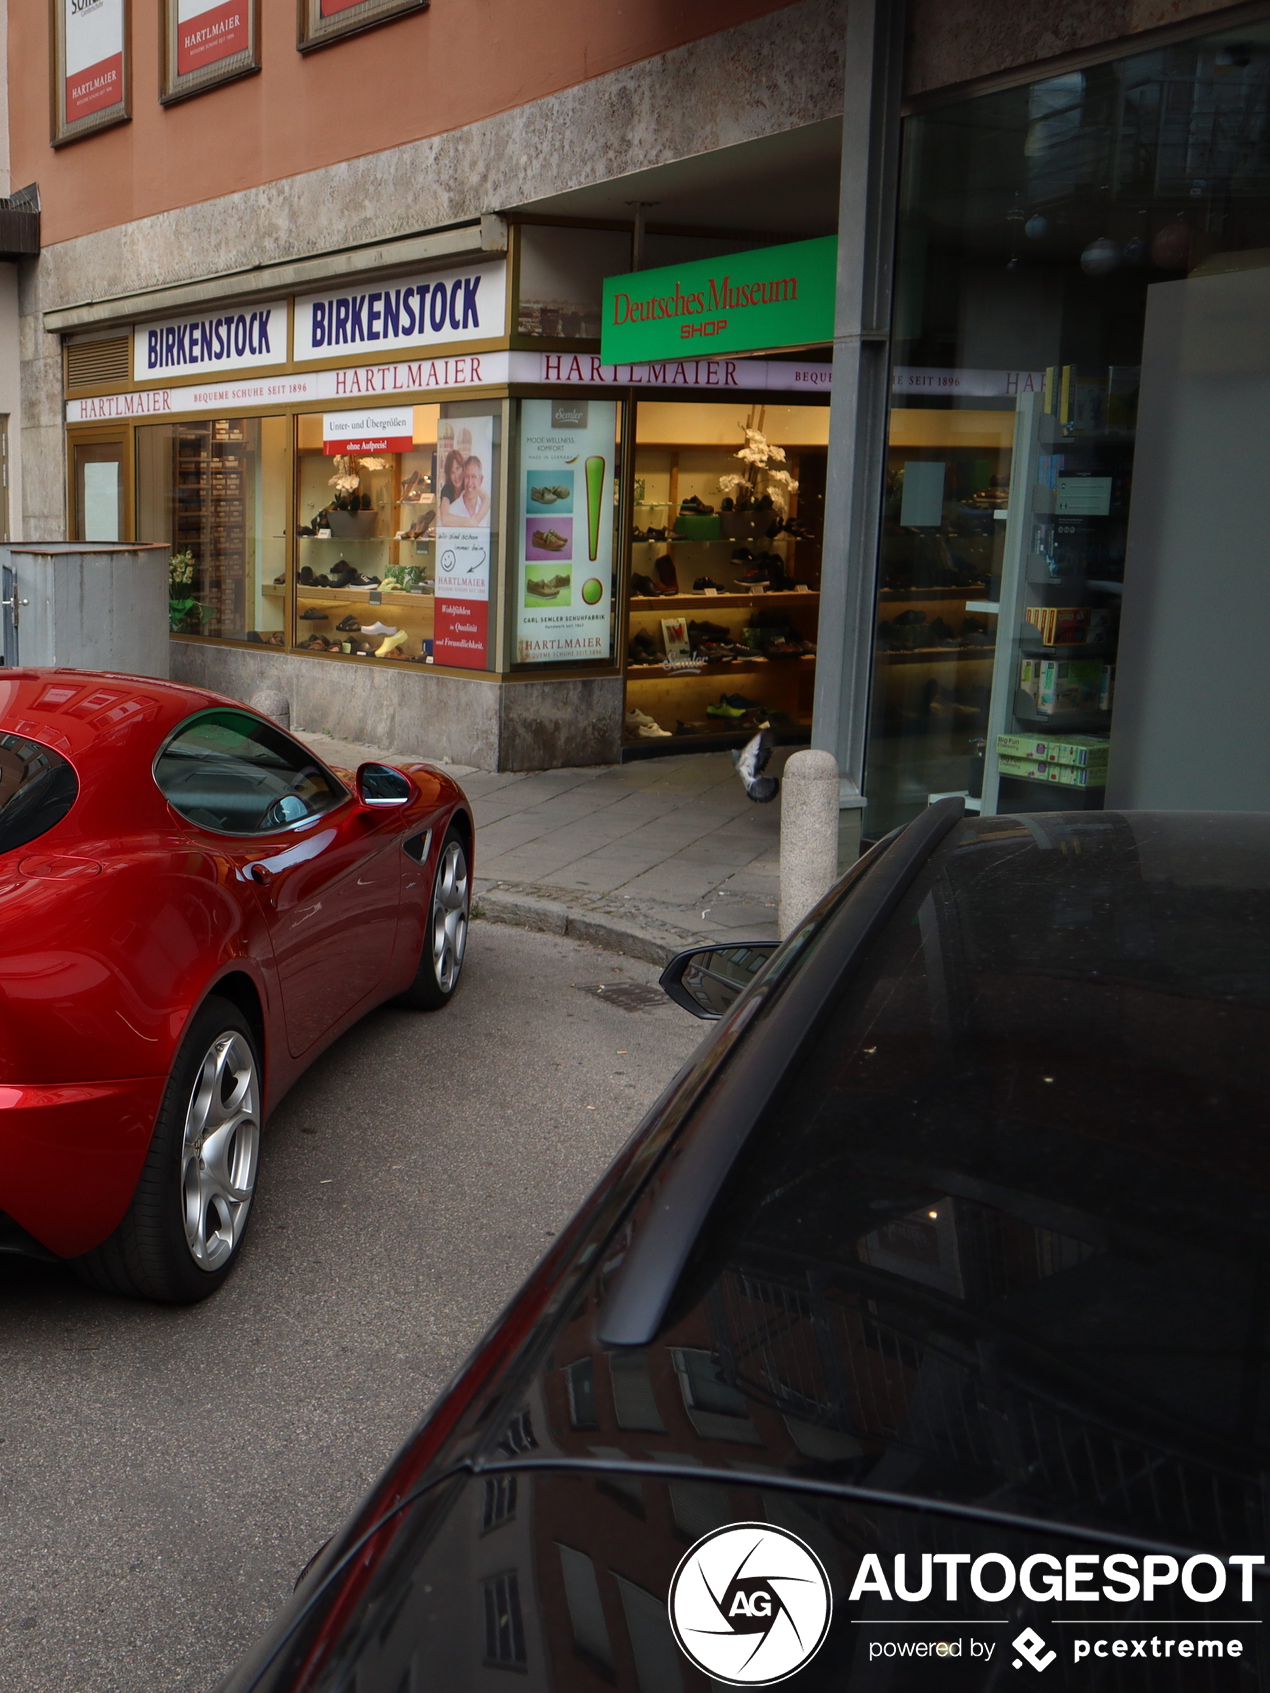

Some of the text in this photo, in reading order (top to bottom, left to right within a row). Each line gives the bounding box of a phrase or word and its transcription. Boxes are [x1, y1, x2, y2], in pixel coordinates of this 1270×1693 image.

[184, 14, 240, 48] HARTLMAIER
[72, 70, 117, 99] HARTLMAIER
[613, 275, 798, 325] Deutsches Museum
[311, 275, 482, 349] BIRKENSTOCK
[680, 319, 728, 339] SHOP
[147, 309, 272, 370] BIRKENSTOCK
[79, 357, 483, 419] HARTLMAIER BEQUEME SCHUHE SEIT 1896 HARTLMAIER
[908, 375, 934, 386] SEIT
[937, 376, 960, 387] 1896
[555, 408, 583, 420] Semler
[329, 417, 407, 431] Unter- und Übergrößen
[346, 440, 387, 452] ohne Aufpreis!
[438, 576, 486, 587] HARTLMAIER
[565, 614, 606, 622] SCHUHFABRIK
[525, 637, 602, 651] HARTLMAIER
[553, 650, 574, 658] SCHUHE
[662, 650, 709, 671] Semler
